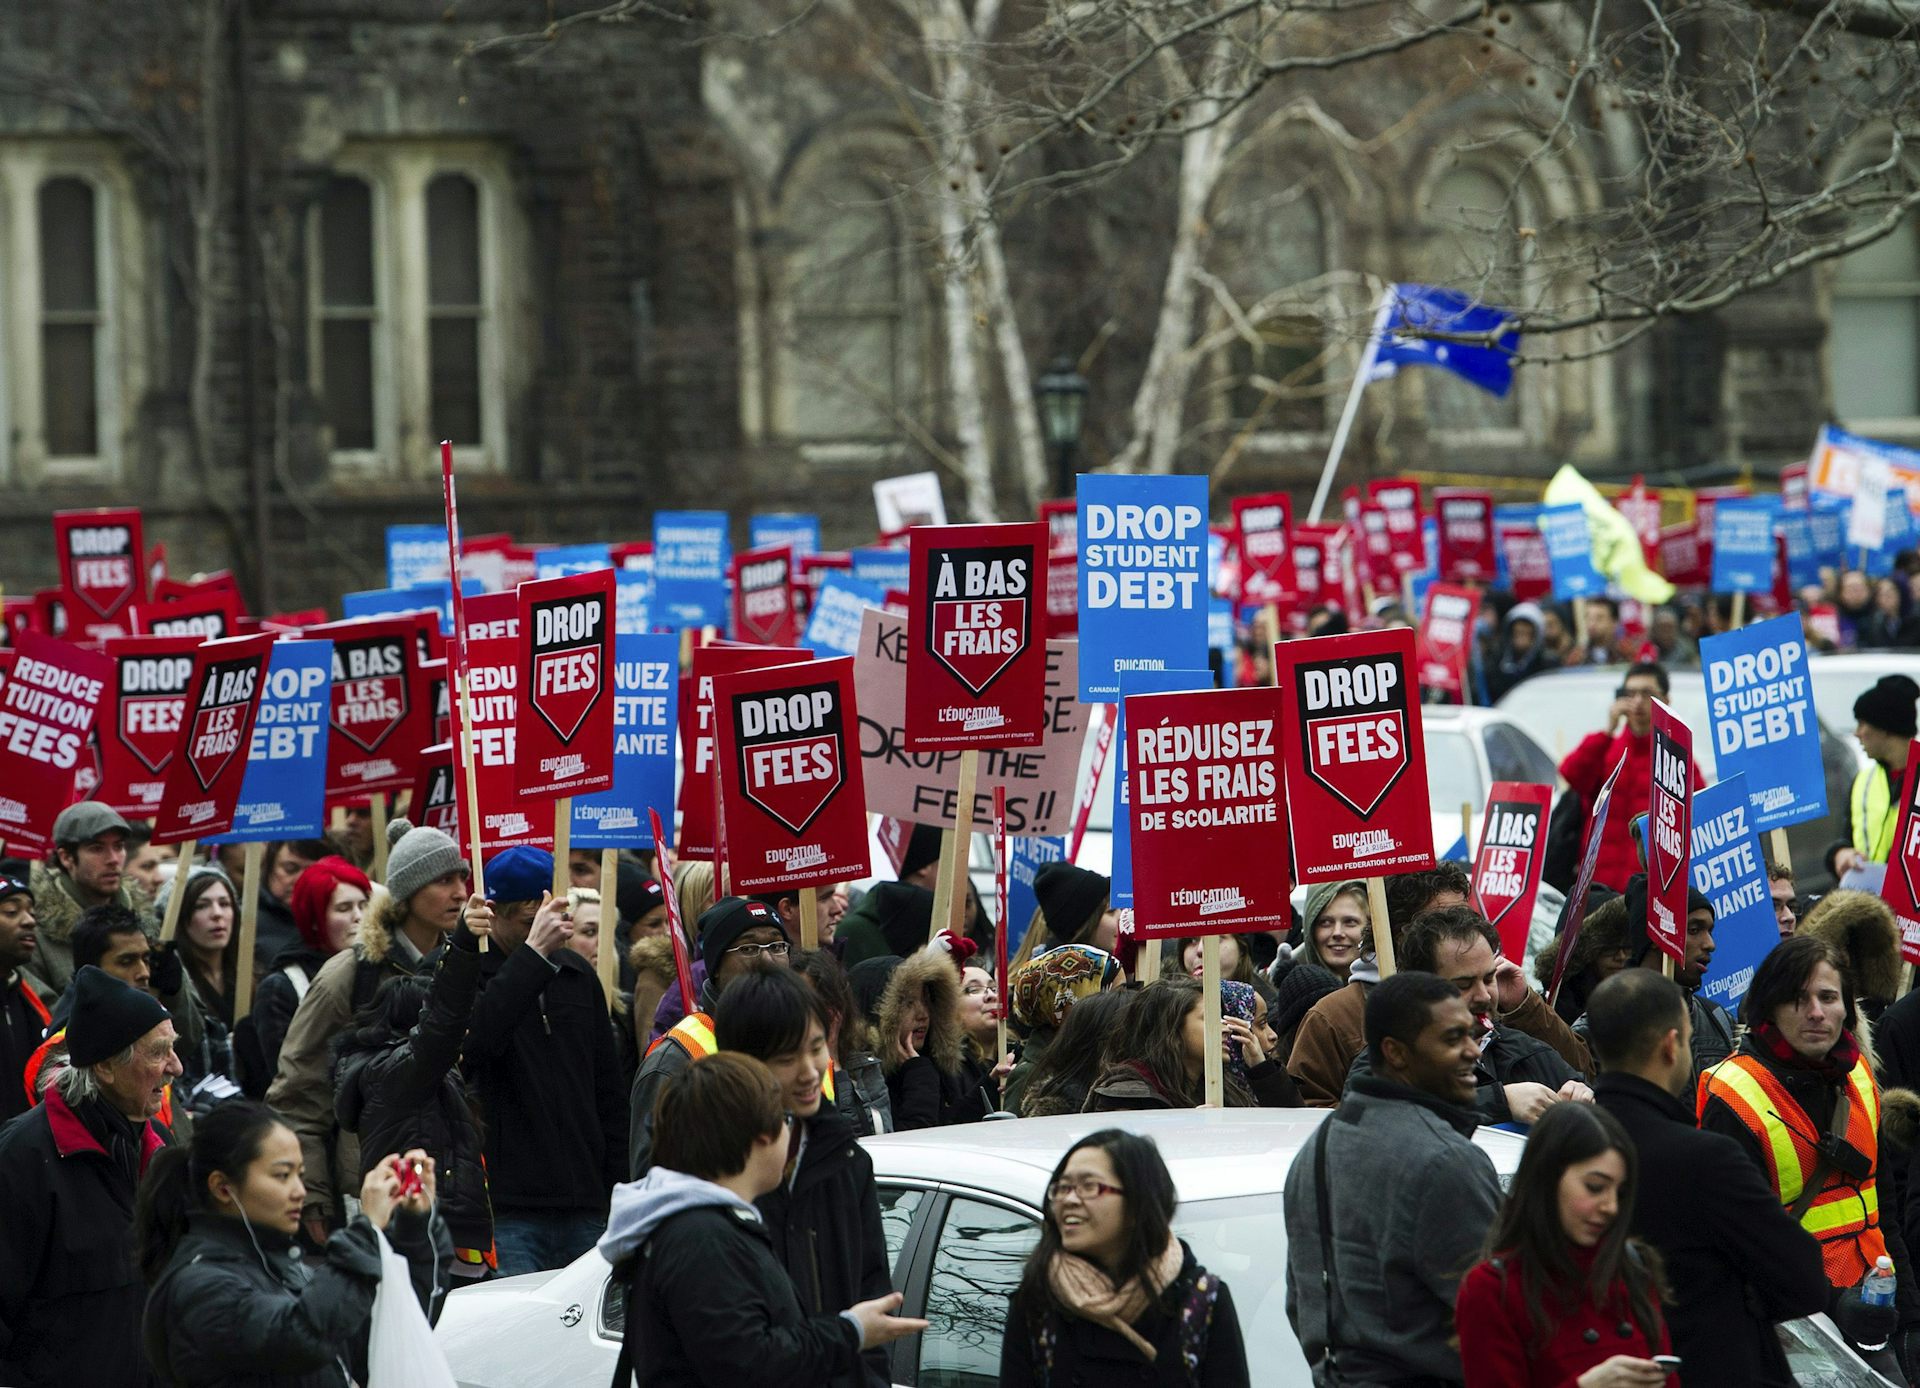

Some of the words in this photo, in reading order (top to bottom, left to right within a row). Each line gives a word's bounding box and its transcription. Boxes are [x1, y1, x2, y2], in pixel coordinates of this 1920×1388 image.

[1086, 505, 1202, 540] DROP
[69, 527, 129, 555] DROP
[1086, 545, 1199, 568] STUDENT
[935, 553, 958, 598] À
[965, 558, 1027, 597] BAS
[1087, 572, 1199, 609] DEBT
[537, 601, 601, 646] DROP
[955, 603, 1003, 630] LES
[943, 628, 1018, 657] FRAIS
[122, 658, 193, 692] DROP
[349, 645, 402, 678] BAS
[540, 652, 596, 697] FEES
[1114, 658, 1165, 673] EDUCATION
[1709, 640, 1802, 695] DROP
[13, 656, 104, 704] REDUCE
[200, 666, 217, 707] À
[218, 667, 257, 705] BAS
[344, 679, 384, 704] LES
[1304, 662, 1398, 711] DROP
[5, 682, 93, 731] TUITION
[256, 702, 322, 724] DENT
[338, 698, 401, 726] FRAIS
[455, 695, 517, 723] UITI
[1713, 675, 1805, 719] STUDENT
[127, 698, 186, 734] FEES
[206, 707, 236, 734] LES
[741, 690, 833, 738] DROP
[938, 705, 1000, 722] L'ÉDUCATION
[1717, 699, 1808, 756] DEBT
[0, 711, 81, 769] FEES
[194, 729, 240, 759] FRAIS
[1011, 731, 1035, 739] ÉTUDIANTS
[1137, 716, 1274, 764] RÉDUISEZ
[1317, 718, 1399, 766] FEES
[540, 753, 582, 773] EDUCATION
[752, 742, 834, 788] FEES
[979, 747, 1046, 779] THE
[1654, 733, 1663, 780] À
[1662, 747, 1686, 800] BAS
[519, 786, 546, 796] CANADIAN
[546, 781, 576, 791] FEDERATION
[584, 775, 609, 785] STUDENTS
[1138, 767, 1189, 806] LES
[1197, 760, 1277, 801] FRAIS
[484, 812, 526, 828] EDUCATION
[574, 804, 634, 820] L'ÉDUCATION
[1140, 811, 1166, 831] DE
[1171, 798, 1277, 829] SCOLARITÉ
[1485, 804, 1500, 845] À
[1501, 811, 1538, 846] BAS
[1659, 799, 1676, 828] LES
[765, 844, 822, 864] EDUCATION
[1332, 829, 1389, 850] EDUCATION
[1655, 816, 1682, 861] FRAIS
[740, 876, 776, 887] CANADIAN
[776, 871, 818, 882] FEDERATION
[829, 863, 863, 875] STUDENTS
[1307, 863, 1343, 874] CANADIAN
[1344, 858, 1386, 870] FEDERATION
[1387, 857, 1397, 865] OF
[1397, 852, 1430, 864] STUDENTS
[1488, 849, 1516, 874] LES
[1693, 841, 1757, 895] DETTE
[1170, 887, 1240, 907] L'ÉDUCATION
[1479, 870, 1522, 898] FRAIS
[1145, 922, 1175, 931] FÉDÉRATION
[1176, 921, 1206, 929] CANADIENNE
[1218, 917, 1247, 925] ÉTUDIANTES
[1254, 914, 1281, 922] ÉTUDIANTS
[1704, 965, 1755, 999] L'ÉDUCATION
